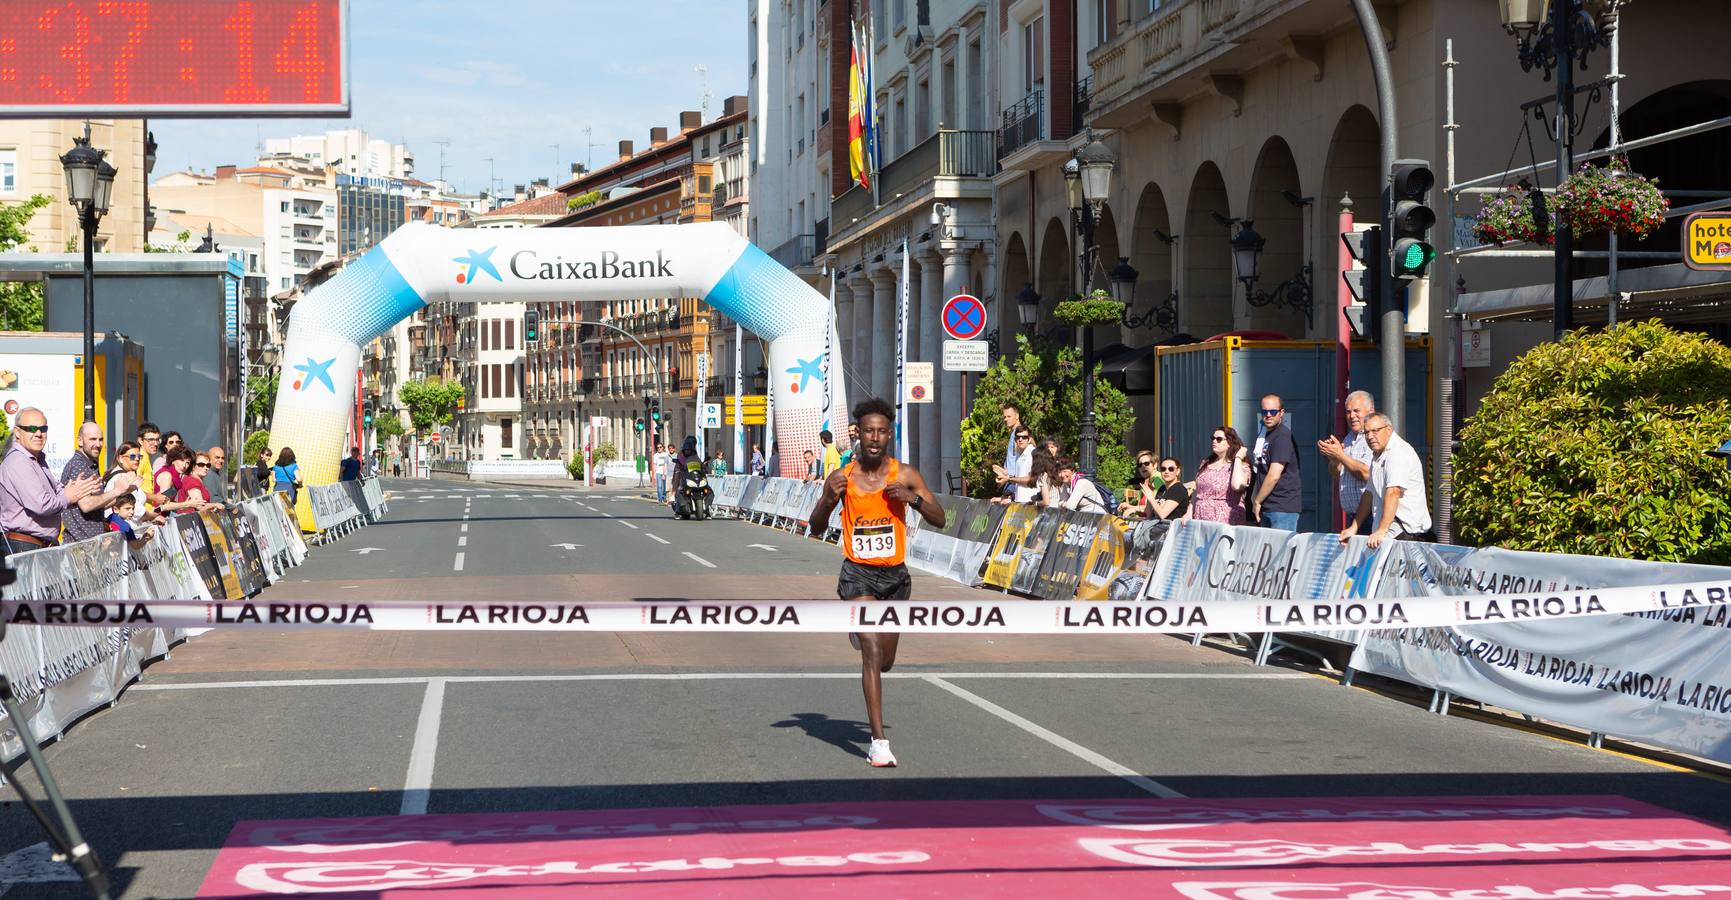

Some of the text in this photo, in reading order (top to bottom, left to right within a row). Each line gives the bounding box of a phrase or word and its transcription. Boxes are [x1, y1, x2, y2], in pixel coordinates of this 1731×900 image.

[510, 248, 675, 280] CaixaBank
[854, 515, 893, 527] Ferrer
[855, 535, 893, 552] 3139
[1207, 534, 1299, 600] CaixaBank
[4, 603, 38, 624] A
[45, 602, 154, 624] RIOJA
[216, 603, 261, 624] LA
[270, 603, 374, 625] RIOJA
[437, 604, 480, 624] LA
[488, 604, 590, 624] RIOJA
[650, 605, 692, 625] LA
[701, 605, 800, 625] RIOJA
[859, 606, 901, 626] LA
[909, 606, 1006, 627] RIOJA
[1064, 606, 1104, 627] LA
[1113, 606, 1209, 627] RIOJA
[1265, 604, 1307, 626] LA
[1313, 602, 1409, 625] RIOJA
[1464, 600, 1506, 621] LA
[1511, 595, 1607, 619] RIOJA
[1660, 589, 1702, 608] LA
[1525, 652, 1546, 678] LA
[1549, 657, 1595, 687] RIOJA
[1596, 667, 1620, 693] LA
[1620, 671, 1672, 702] RIOJA
[1676, 680, 1702, 709] LA
[287, 850, 930, 883] Cadarso
